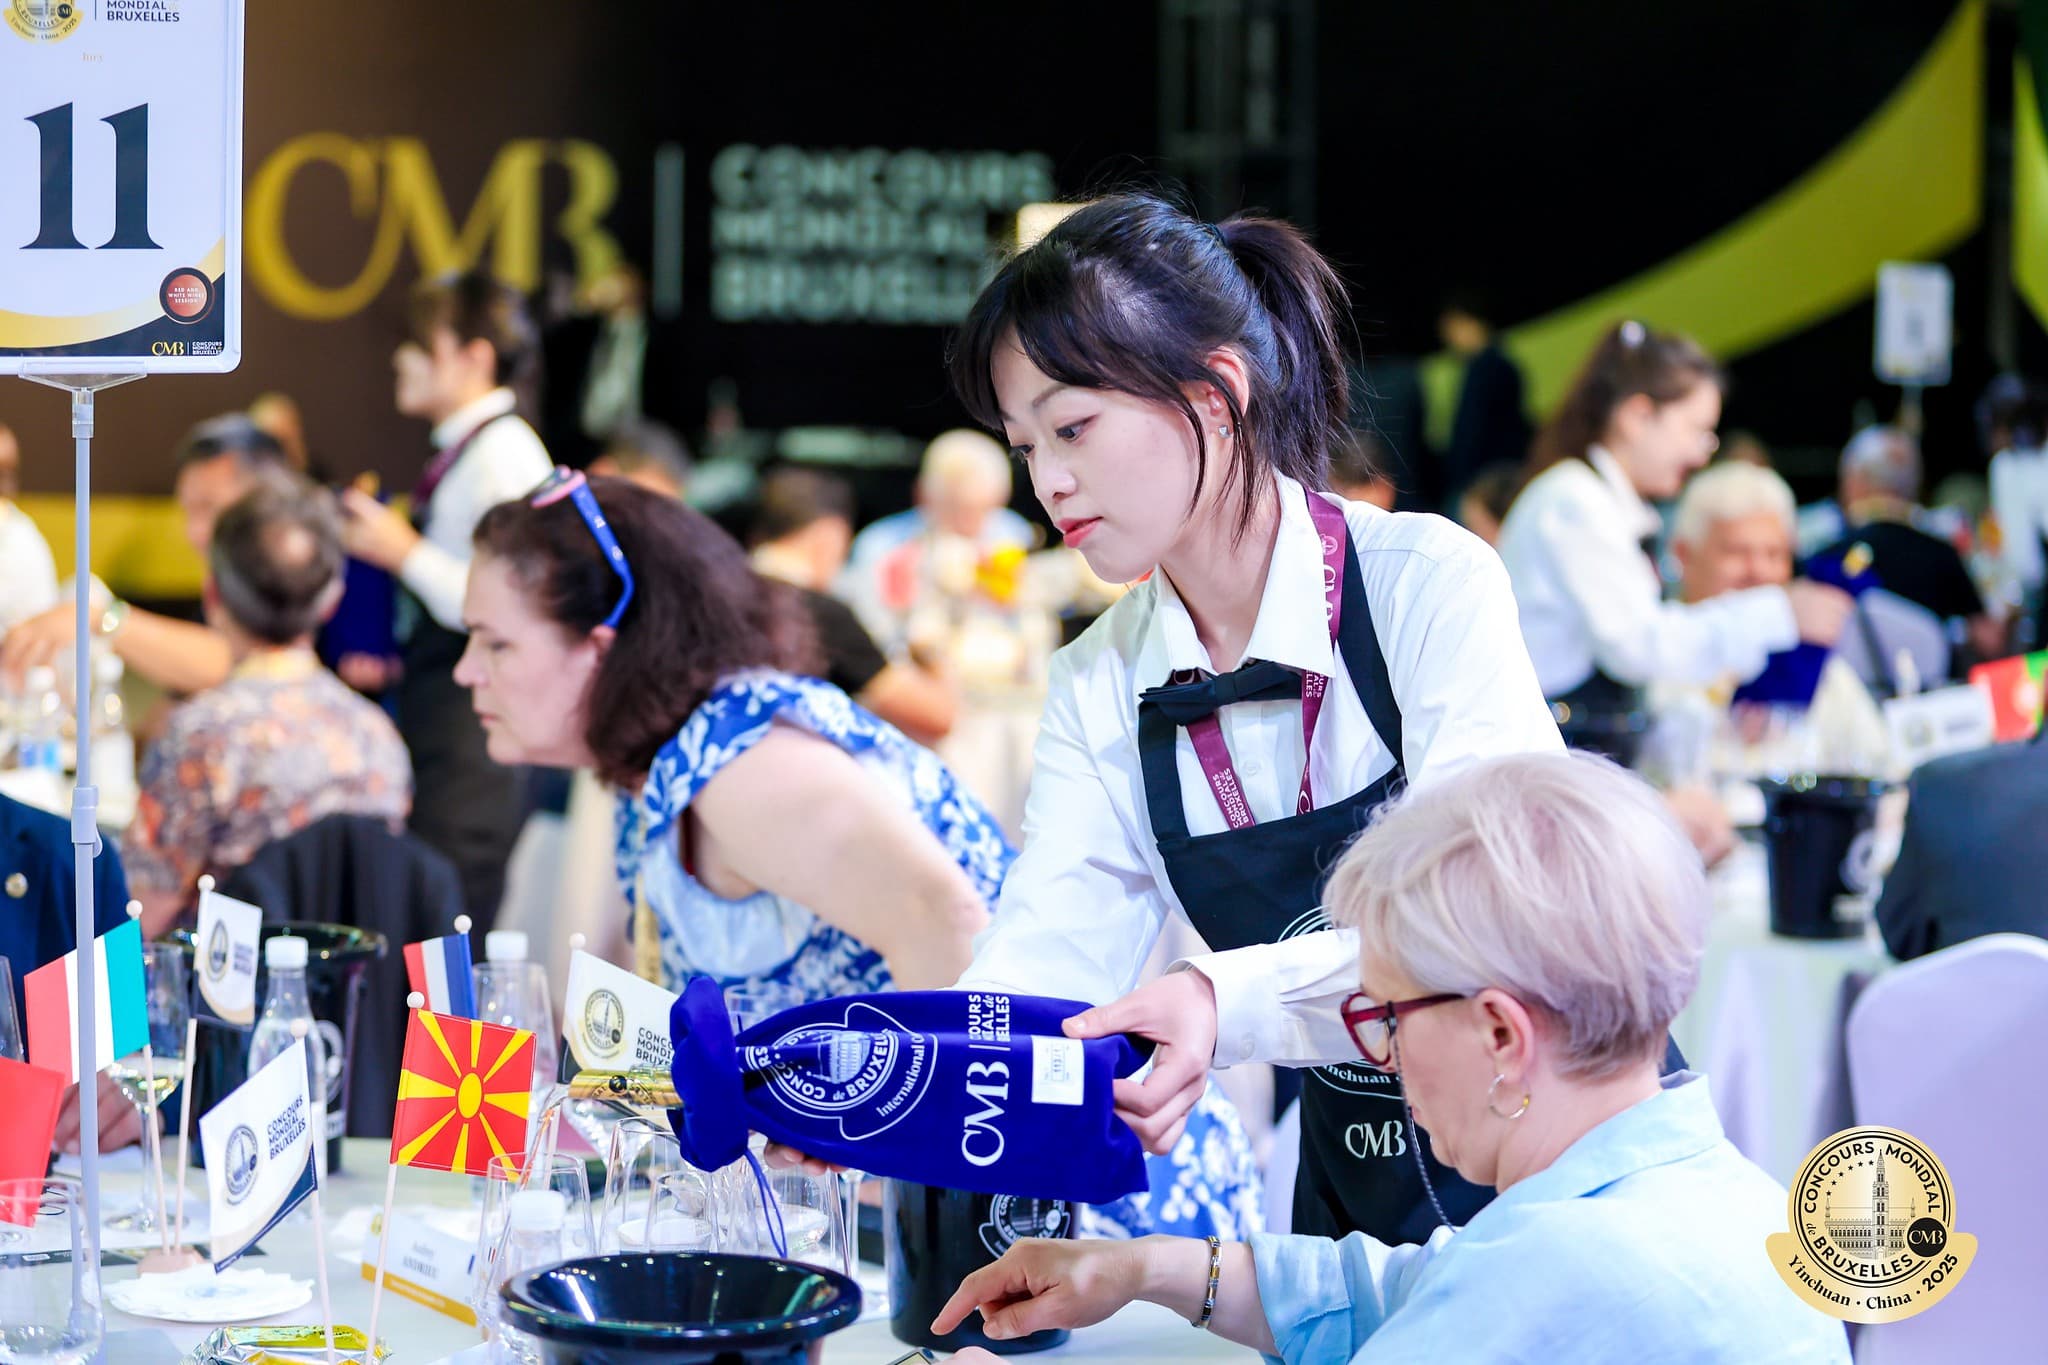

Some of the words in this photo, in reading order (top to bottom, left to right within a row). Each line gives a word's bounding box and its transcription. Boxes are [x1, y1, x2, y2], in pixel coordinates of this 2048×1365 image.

[107, 0, 166, 10] MONDIAL
[107, 11, 180, 22] BRUXELLES
[18, 101, 165, 250] 11
[151, 341, 184, 356] CMB
[1213, 774, 1239, 828] CONCOURS
[1222, 780, 1245, 826] MONDIAL
[1223, 768, 1250, 824] BRUXELLES
[267, 1094, 303, 1136] CONCOURS
[269, 1112, 299, 1145] MONDIAL
[961, 1061, 1011, 1167] CMB
[270, 1117, 306, 1161] BRUXELLES
[1345, 1119, 1407, 1159] CMB
